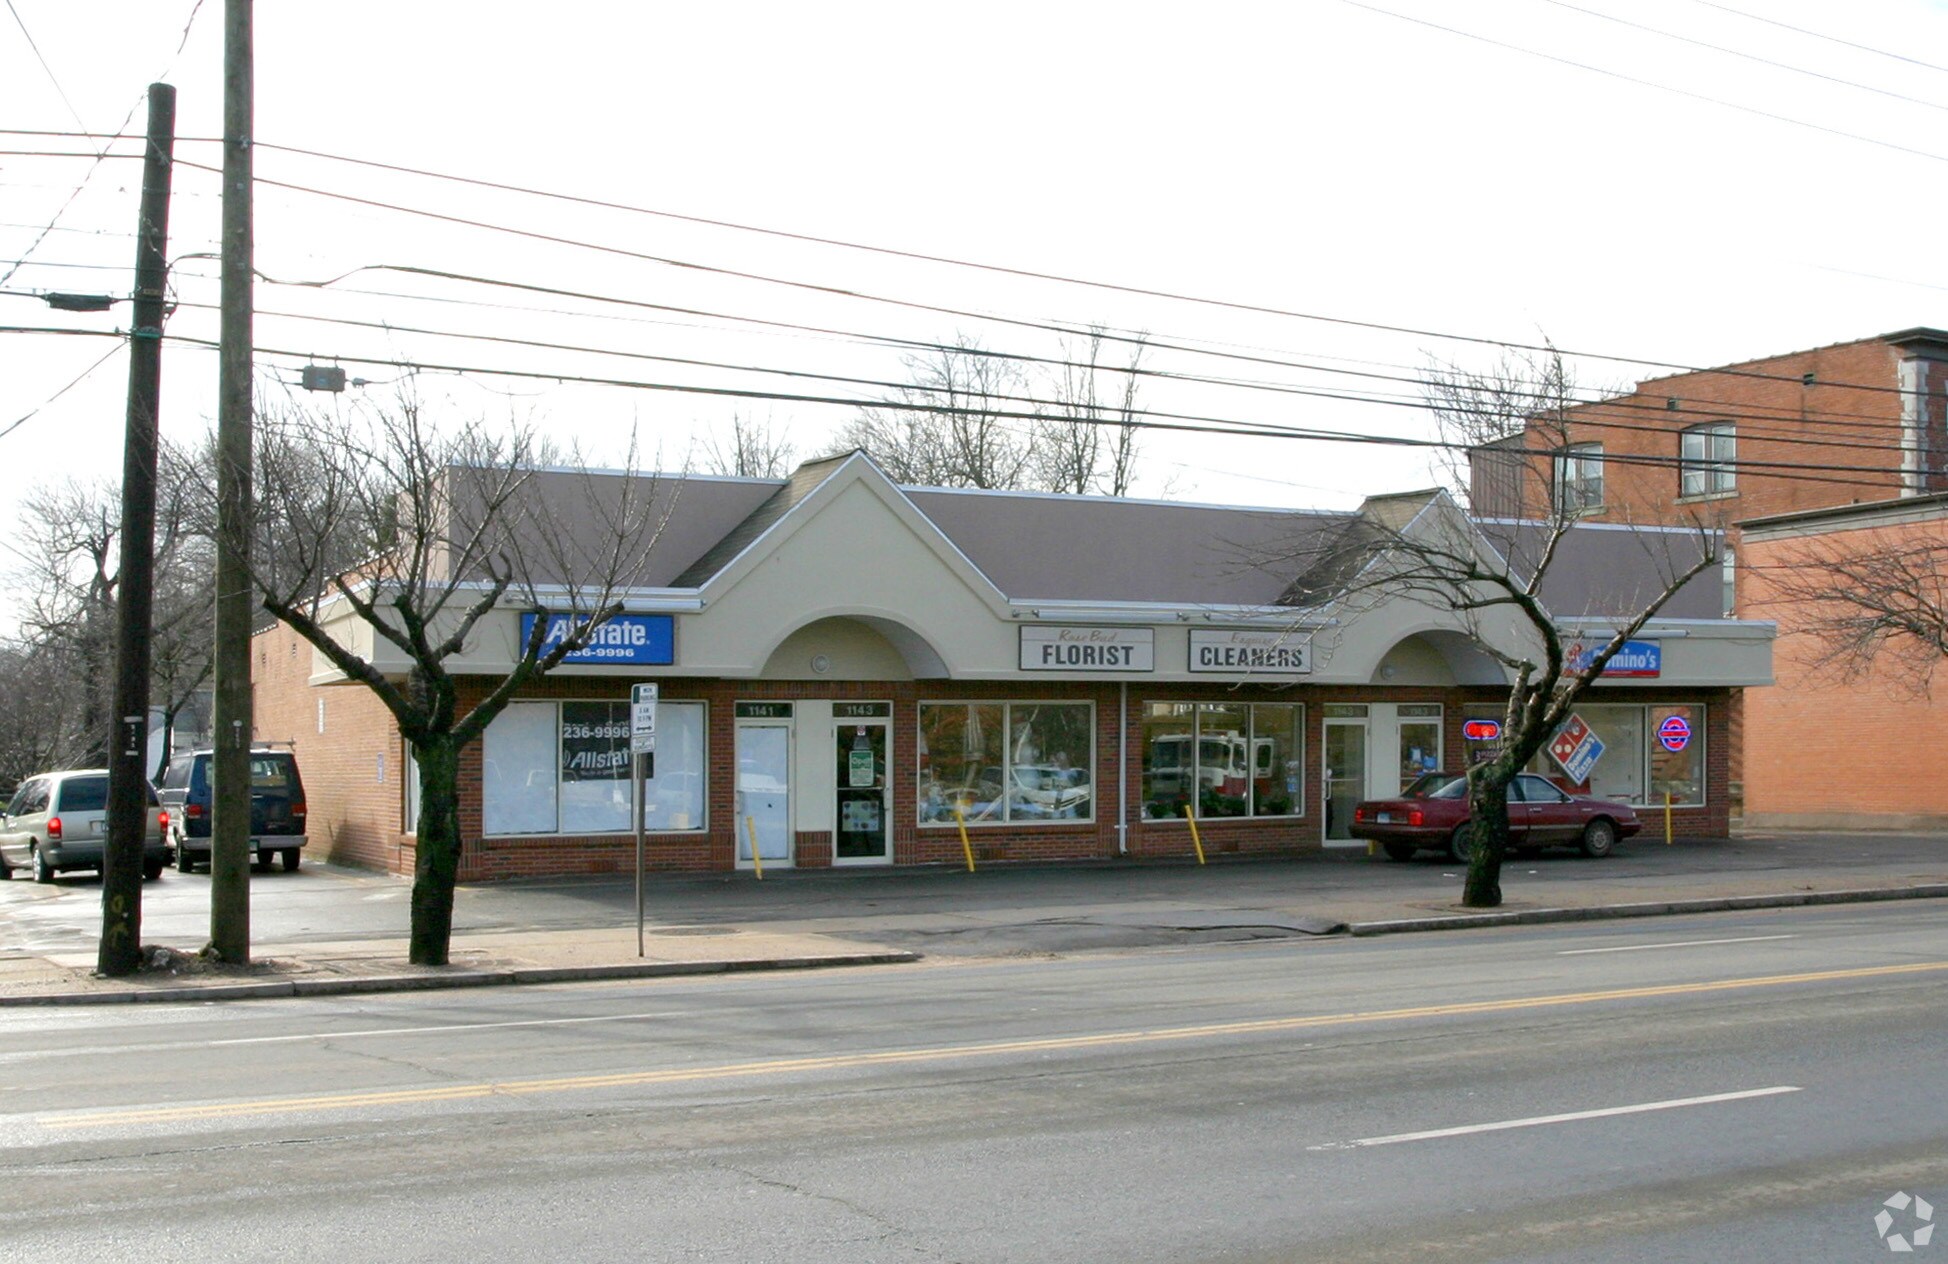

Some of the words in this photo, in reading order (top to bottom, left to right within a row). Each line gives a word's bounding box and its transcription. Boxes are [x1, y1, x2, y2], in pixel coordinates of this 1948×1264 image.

[1042, 644, 1134, 666] FLORIST
[1200, 646, 1303, 667] CLEANERS
[1593, 648, 1657, 669] mino's
[748, 705, 774, 716] 1141
[846, 705, 874, 716] 1143
[563, 726, 630, 738] 236-9996
[570, 747, 630, 769] Allstat
